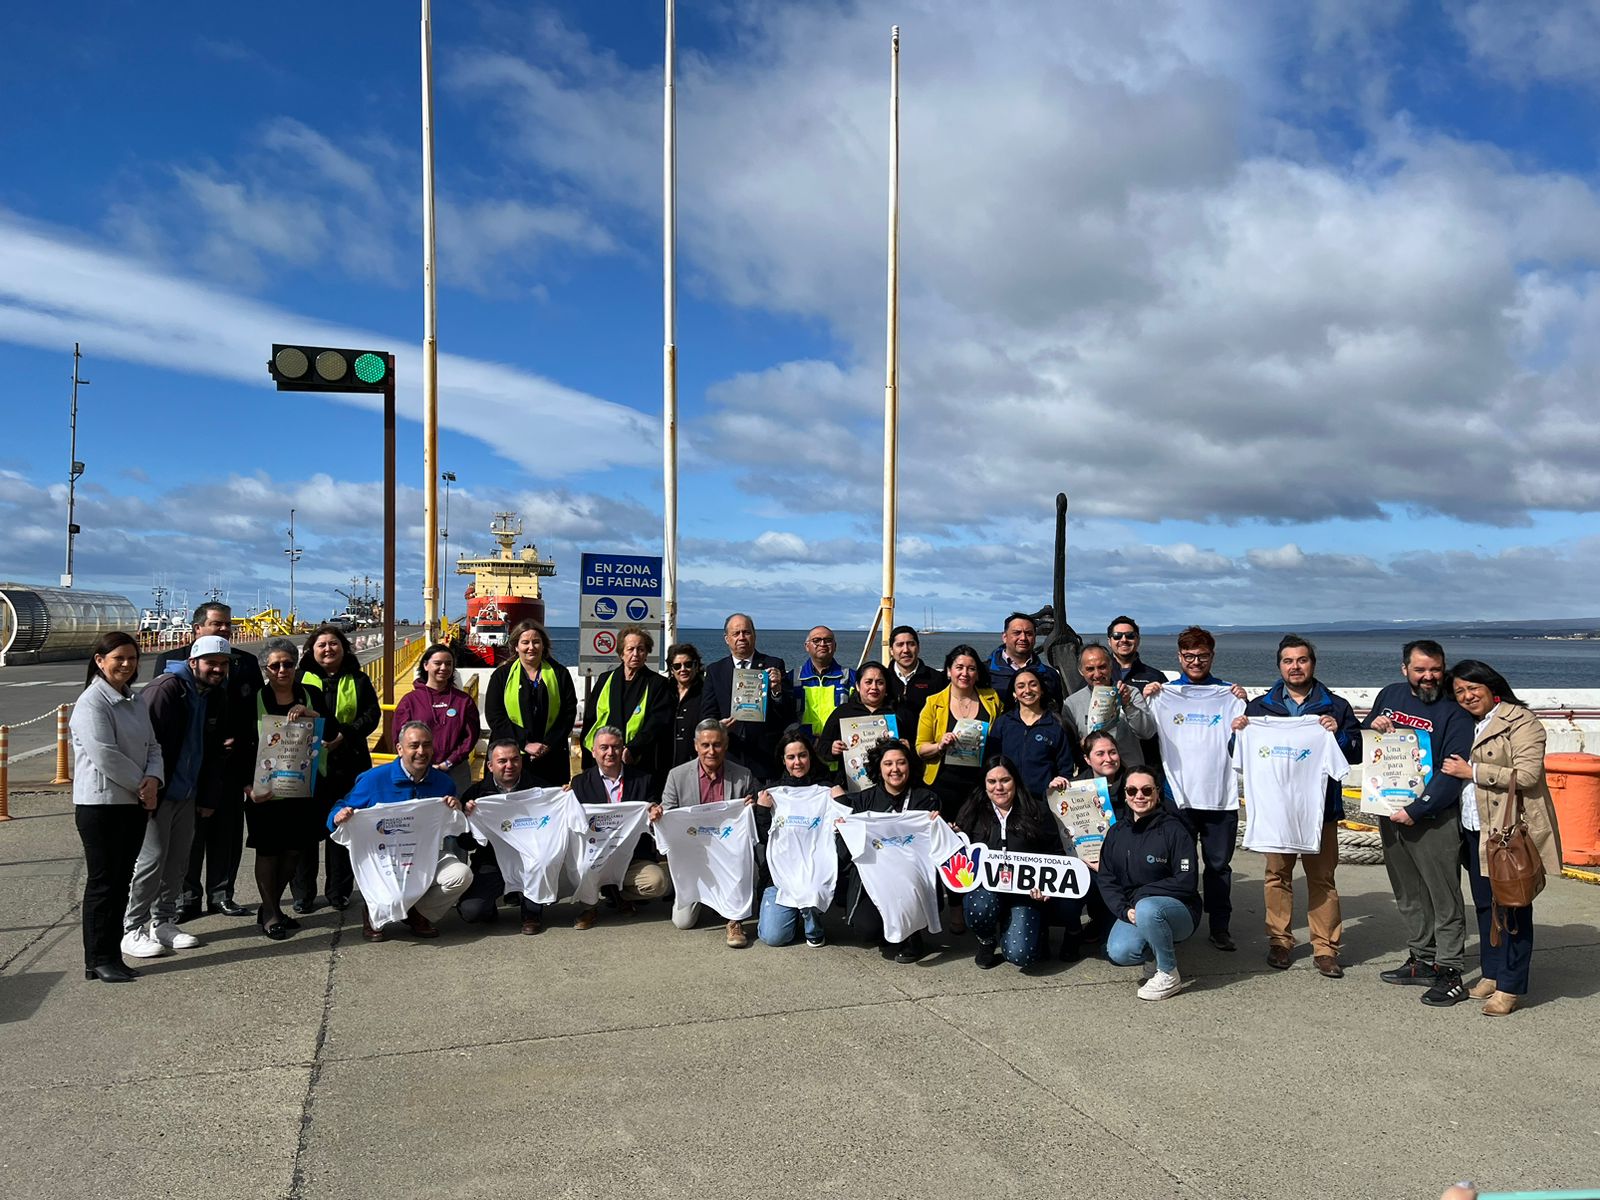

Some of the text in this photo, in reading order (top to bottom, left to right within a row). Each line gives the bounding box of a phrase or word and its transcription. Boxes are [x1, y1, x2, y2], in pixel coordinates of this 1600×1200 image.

[595, 563, 651, 575] EN ZONA
[586, 576, 658, 588] DE FAENAS
